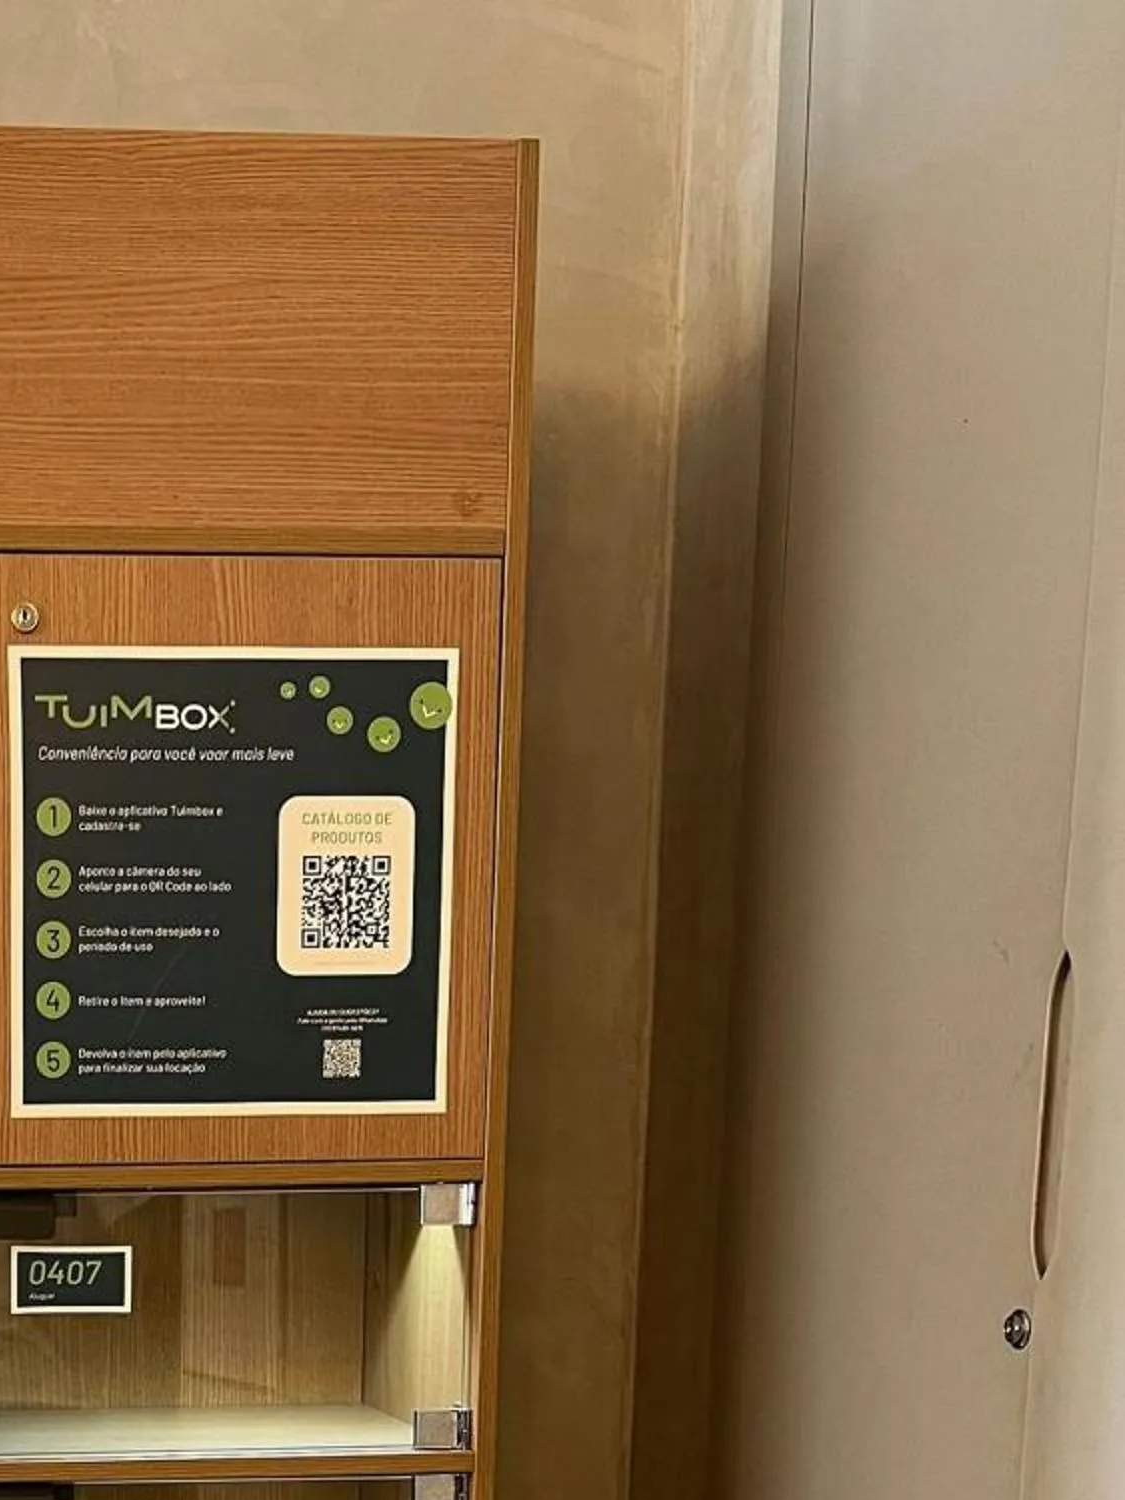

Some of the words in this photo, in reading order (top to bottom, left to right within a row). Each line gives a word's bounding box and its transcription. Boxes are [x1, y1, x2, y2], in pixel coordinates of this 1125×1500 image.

[35, 695, 236, 734] TUIMBOX
[38, 745, 127, 761] Conveniência
[130, 749, 161, 763] para
[165, 746, 196, 761] você
[200, 749, 228, 760] voar
[232, 747, 264, 761] mais
[267, 747, 294, 760] leve
[50, 805, 57, 828] 1
[78, 805, 107, 817] Baixe
[109, 807, 116, 817] o
[118, 805, 168, 819] aplicativo
[216, 807, 224, 817] e
[302, 810, 372, 825] CATÁLOGO
[374, 813, 392, 825] DE
[78, 820, 142, 832] cadastre-se
[312, 831, 383, 844] PRODUTOS
[47, 866, 60, 890] 2
[117, 868, 124, 877] a
[126, 866, 165, 877] câmera
[167, 866, 180, 877] do
[182, 868, 202, 877] seu
[78, 881, 113, 892] celular
[115, 883, 139, 894] para
[141, 883, 148, 892] o
[148, 881, 164, 893] QR
[165, 881, 192, 892] Code
[194, 883, 207, 892] ao
[209, 881, 232, 892] lado
[78, 925, 120, 937] Escolha
[121, 928, 128, 937] o
[155, 926, 202, 939] desejado
[204, 928, 211, 937] e
[213, 928, 220, 937] o
[47, 929, 60, 952] 3
[119, 941, 132, 952] de
[134, 943, 154, 952] uso
[46, 990, 60, 1012] 4
[78, 995, 109, 1007] Retire
[111, 998, 118, 1007] o
[120, 995, 144, 1007] item
[145, 998, 152, 1007] e
[154, 995, 206, 1008] aproveite!
[46, 1049, 60, 1072] 5
[78, 1048, 117, 1059] Devolva
[119, 1050, 126, 1059] o
[153, 1048, 176, 1061] pelo
[78, 1064, 101, 1075] para
[102, 1062, 144, 1073] finalizar
[145, 1064, 163, 1073] sua
[28, 1260, 102, 1286] 0407
